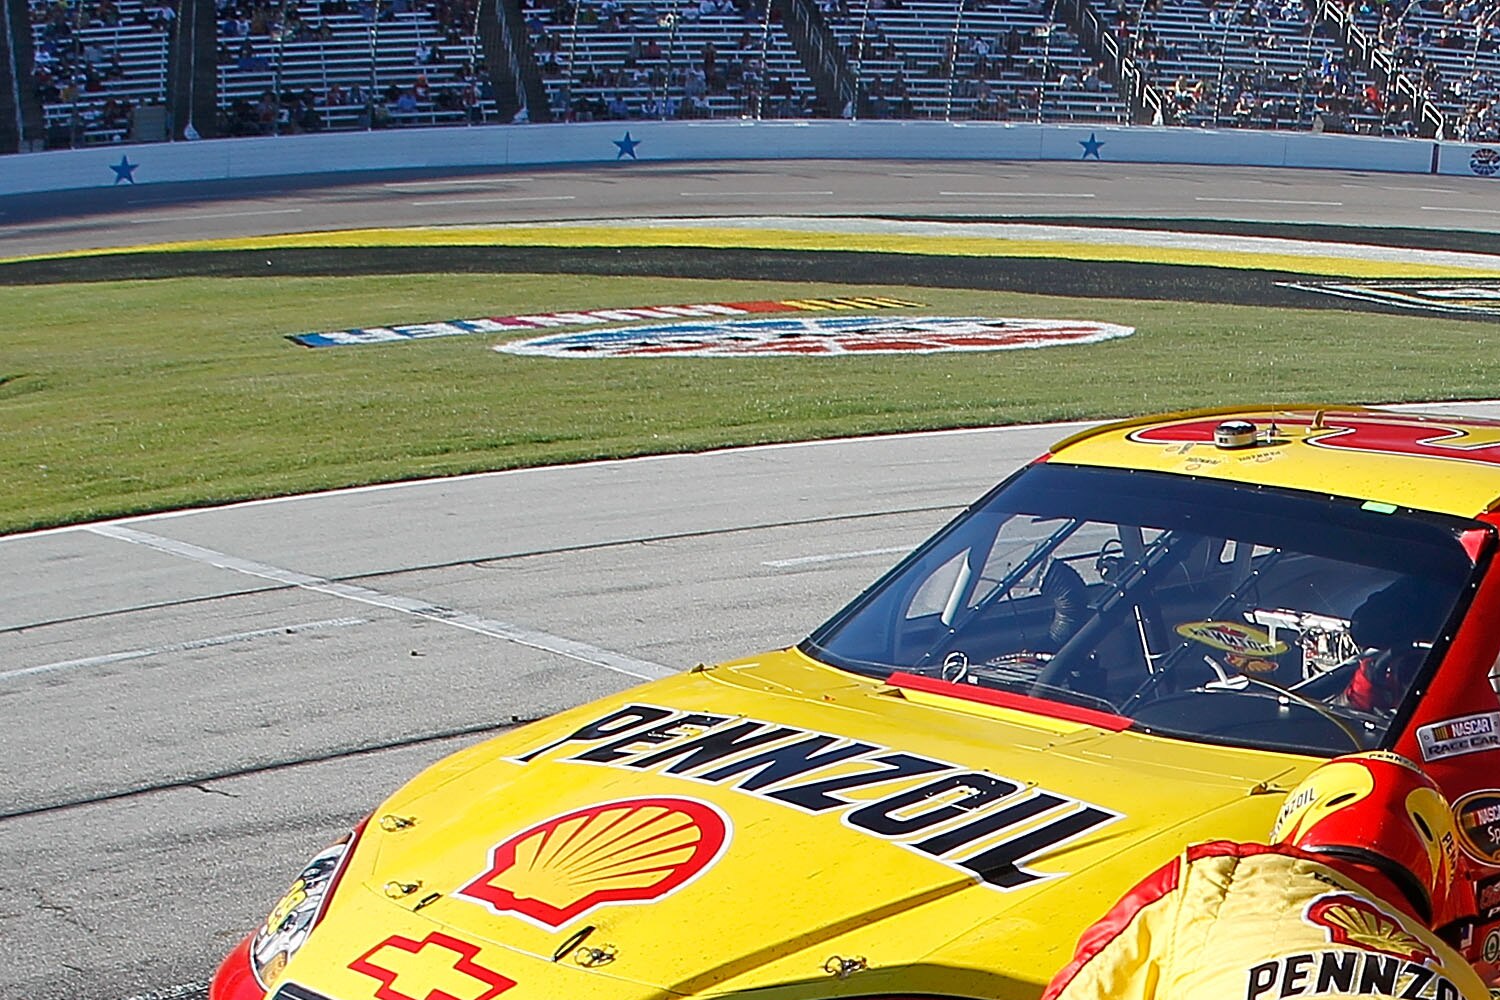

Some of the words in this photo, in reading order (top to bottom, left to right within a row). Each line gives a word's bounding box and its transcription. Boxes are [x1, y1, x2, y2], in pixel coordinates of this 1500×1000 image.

[1450, 717, 1493, 736] NASCAR
[1428, 739, 1469, 756] RACE
[1470, 735, 1500, 749] CAR
[502, 702, 1127, 892] PENNZOIL
